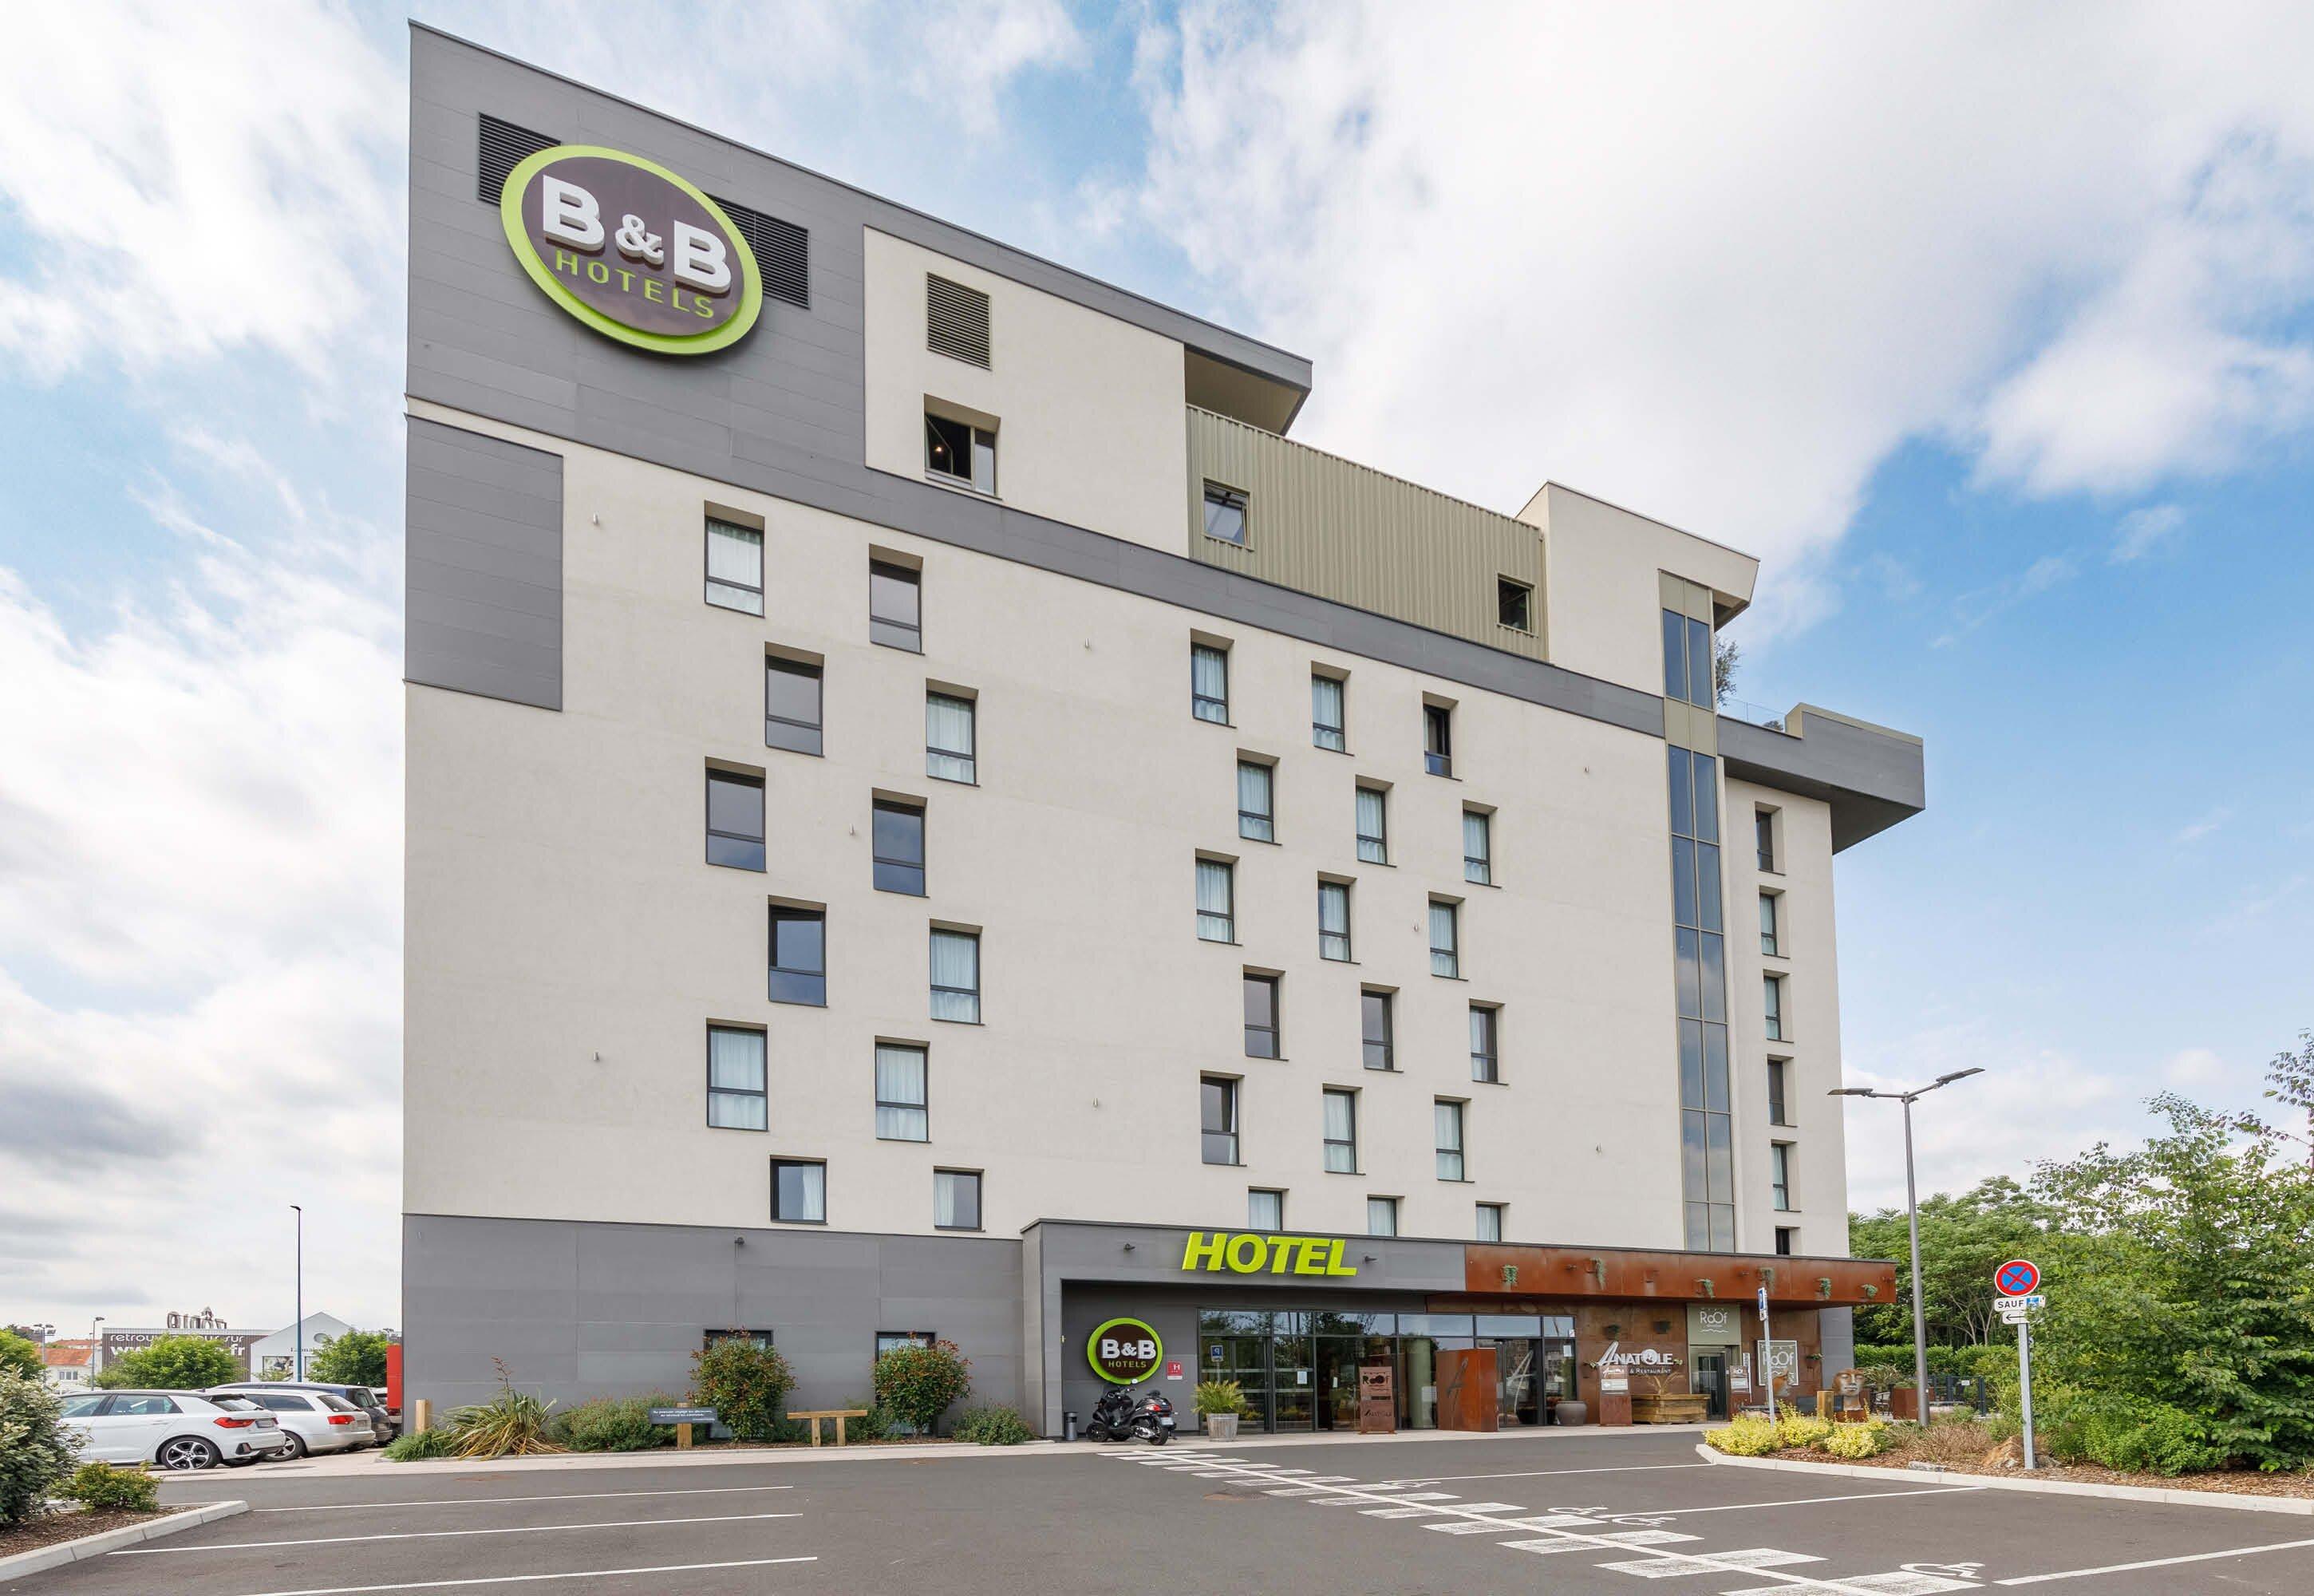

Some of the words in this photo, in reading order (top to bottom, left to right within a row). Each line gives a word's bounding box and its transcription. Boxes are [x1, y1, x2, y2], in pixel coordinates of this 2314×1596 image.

[543, 175, 732, 294] B&B
[555, 251, 715, 319] HOTELS
[1182, 1231, 1357, 1276] HOTEL
[1997, 1299, 2024, 1309] SAUF
[1102, 1339, 1156, 1359] B&B
